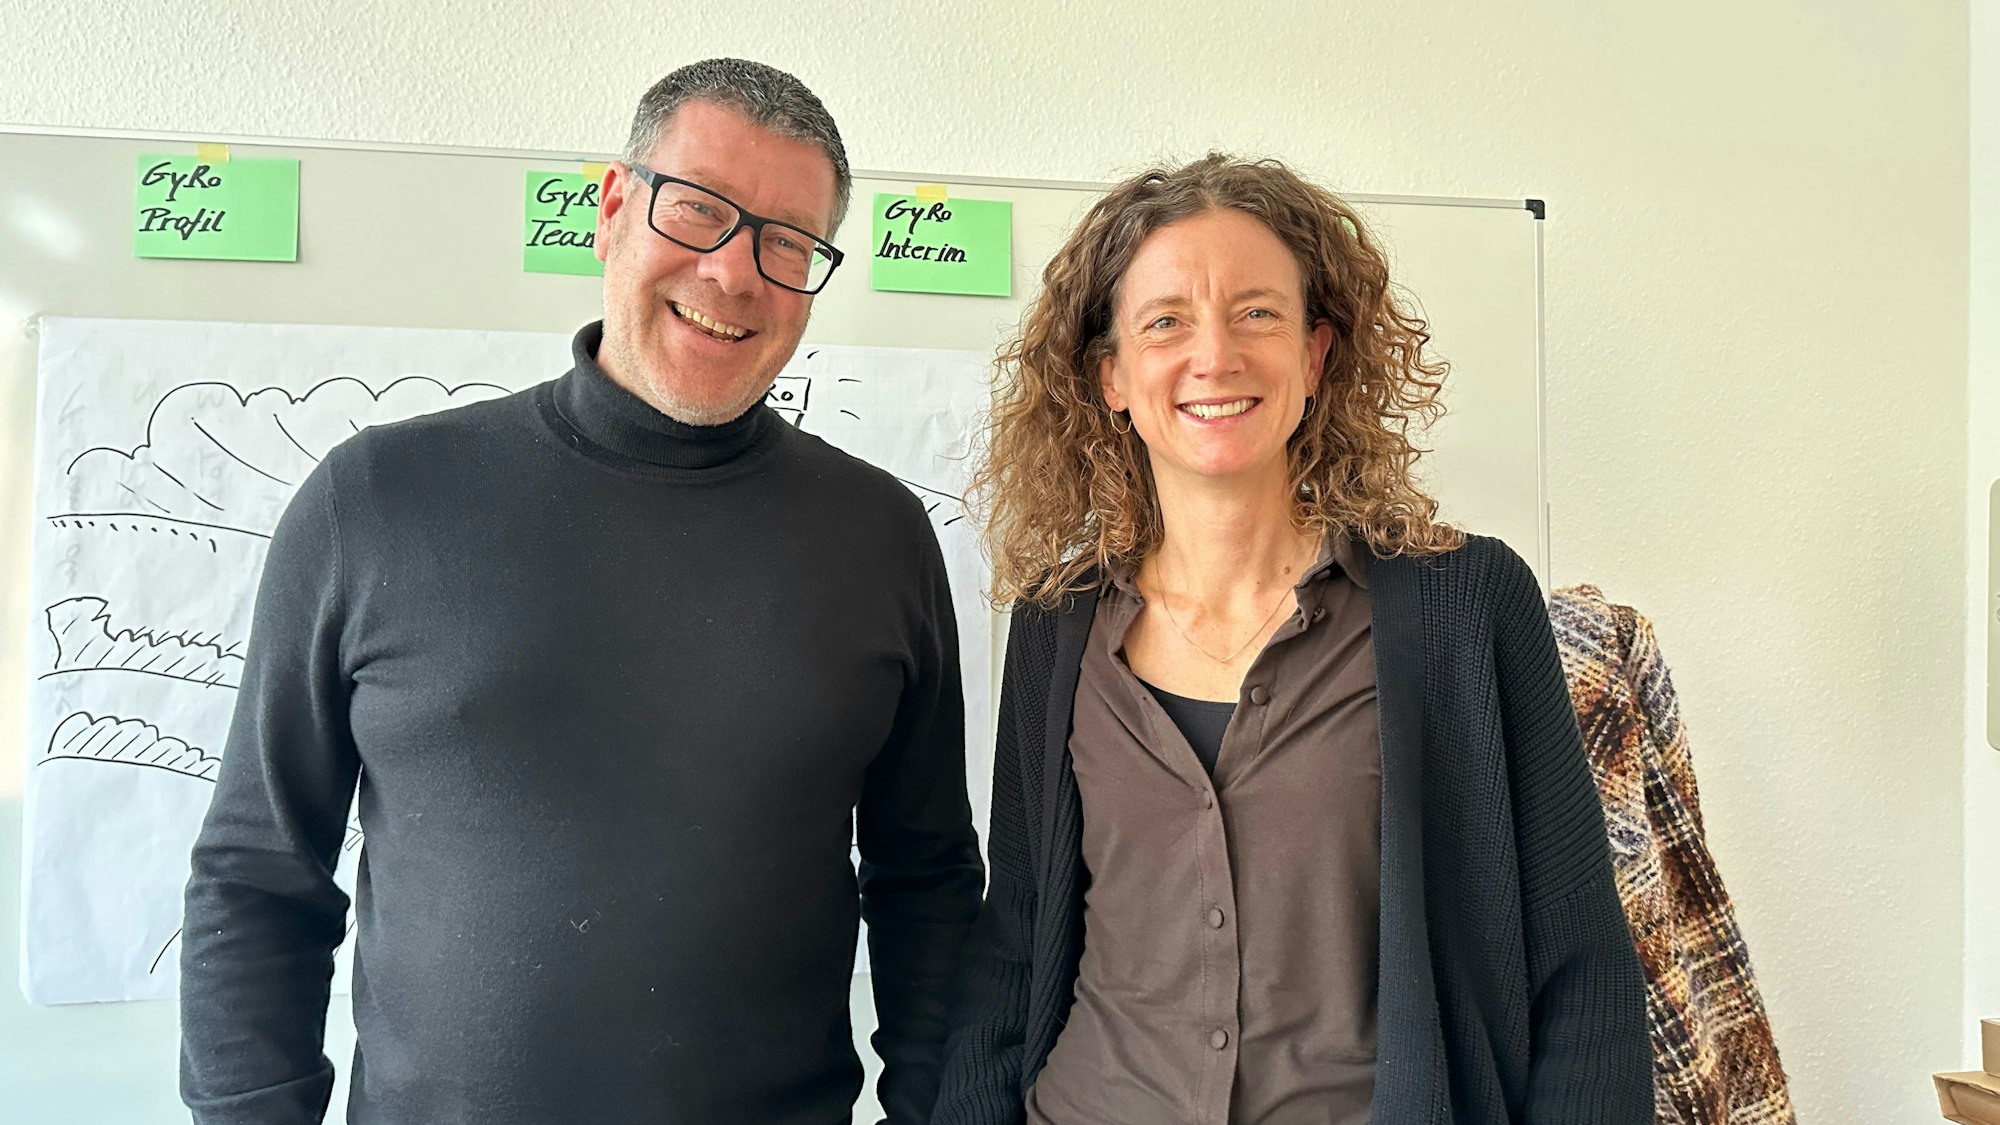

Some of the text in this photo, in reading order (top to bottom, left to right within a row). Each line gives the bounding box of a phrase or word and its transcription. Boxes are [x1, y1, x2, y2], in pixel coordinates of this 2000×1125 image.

[141, 161, 222, 202] GyRo
[138, 207, 226, 241] Profil
[884, 199, 952, 235] GyRo
[875, 230, 968, 263] Interim
